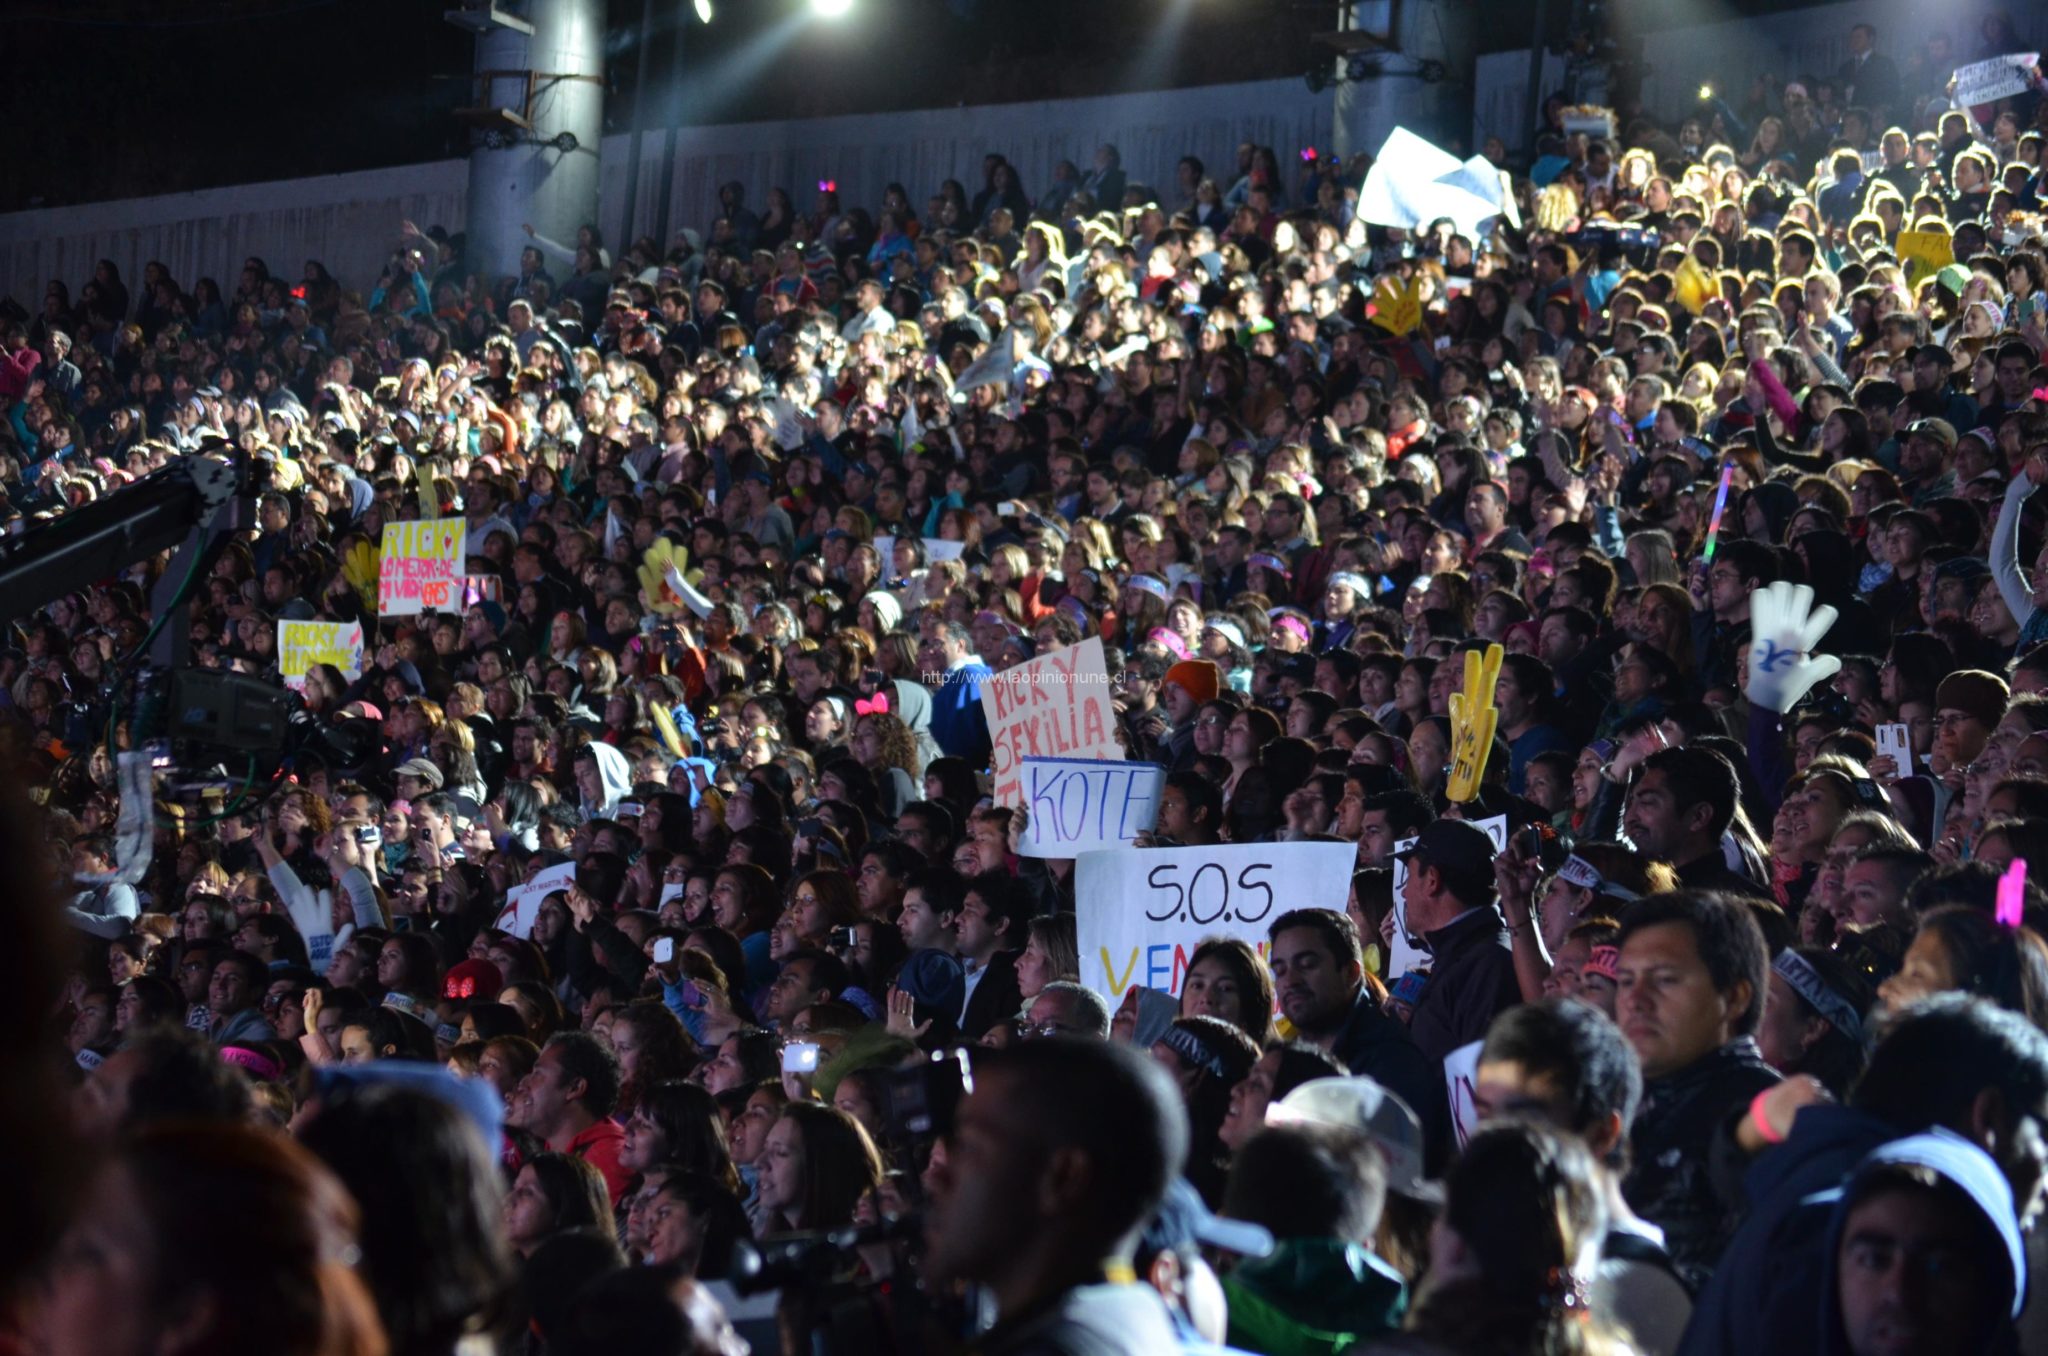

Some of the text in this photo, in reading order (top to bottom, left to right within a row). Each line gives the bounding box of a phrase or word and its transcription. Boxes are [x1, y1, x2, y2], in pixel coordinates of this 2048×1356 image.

[381, 520, 465, 560] RICKY
[284, 623, 340, 647] RICKY
[991, 646, 1079, 720] RICKY
[1032, 767, 1156, 844] KOTE
[1145, 862, 1274, 925] S.O.S
